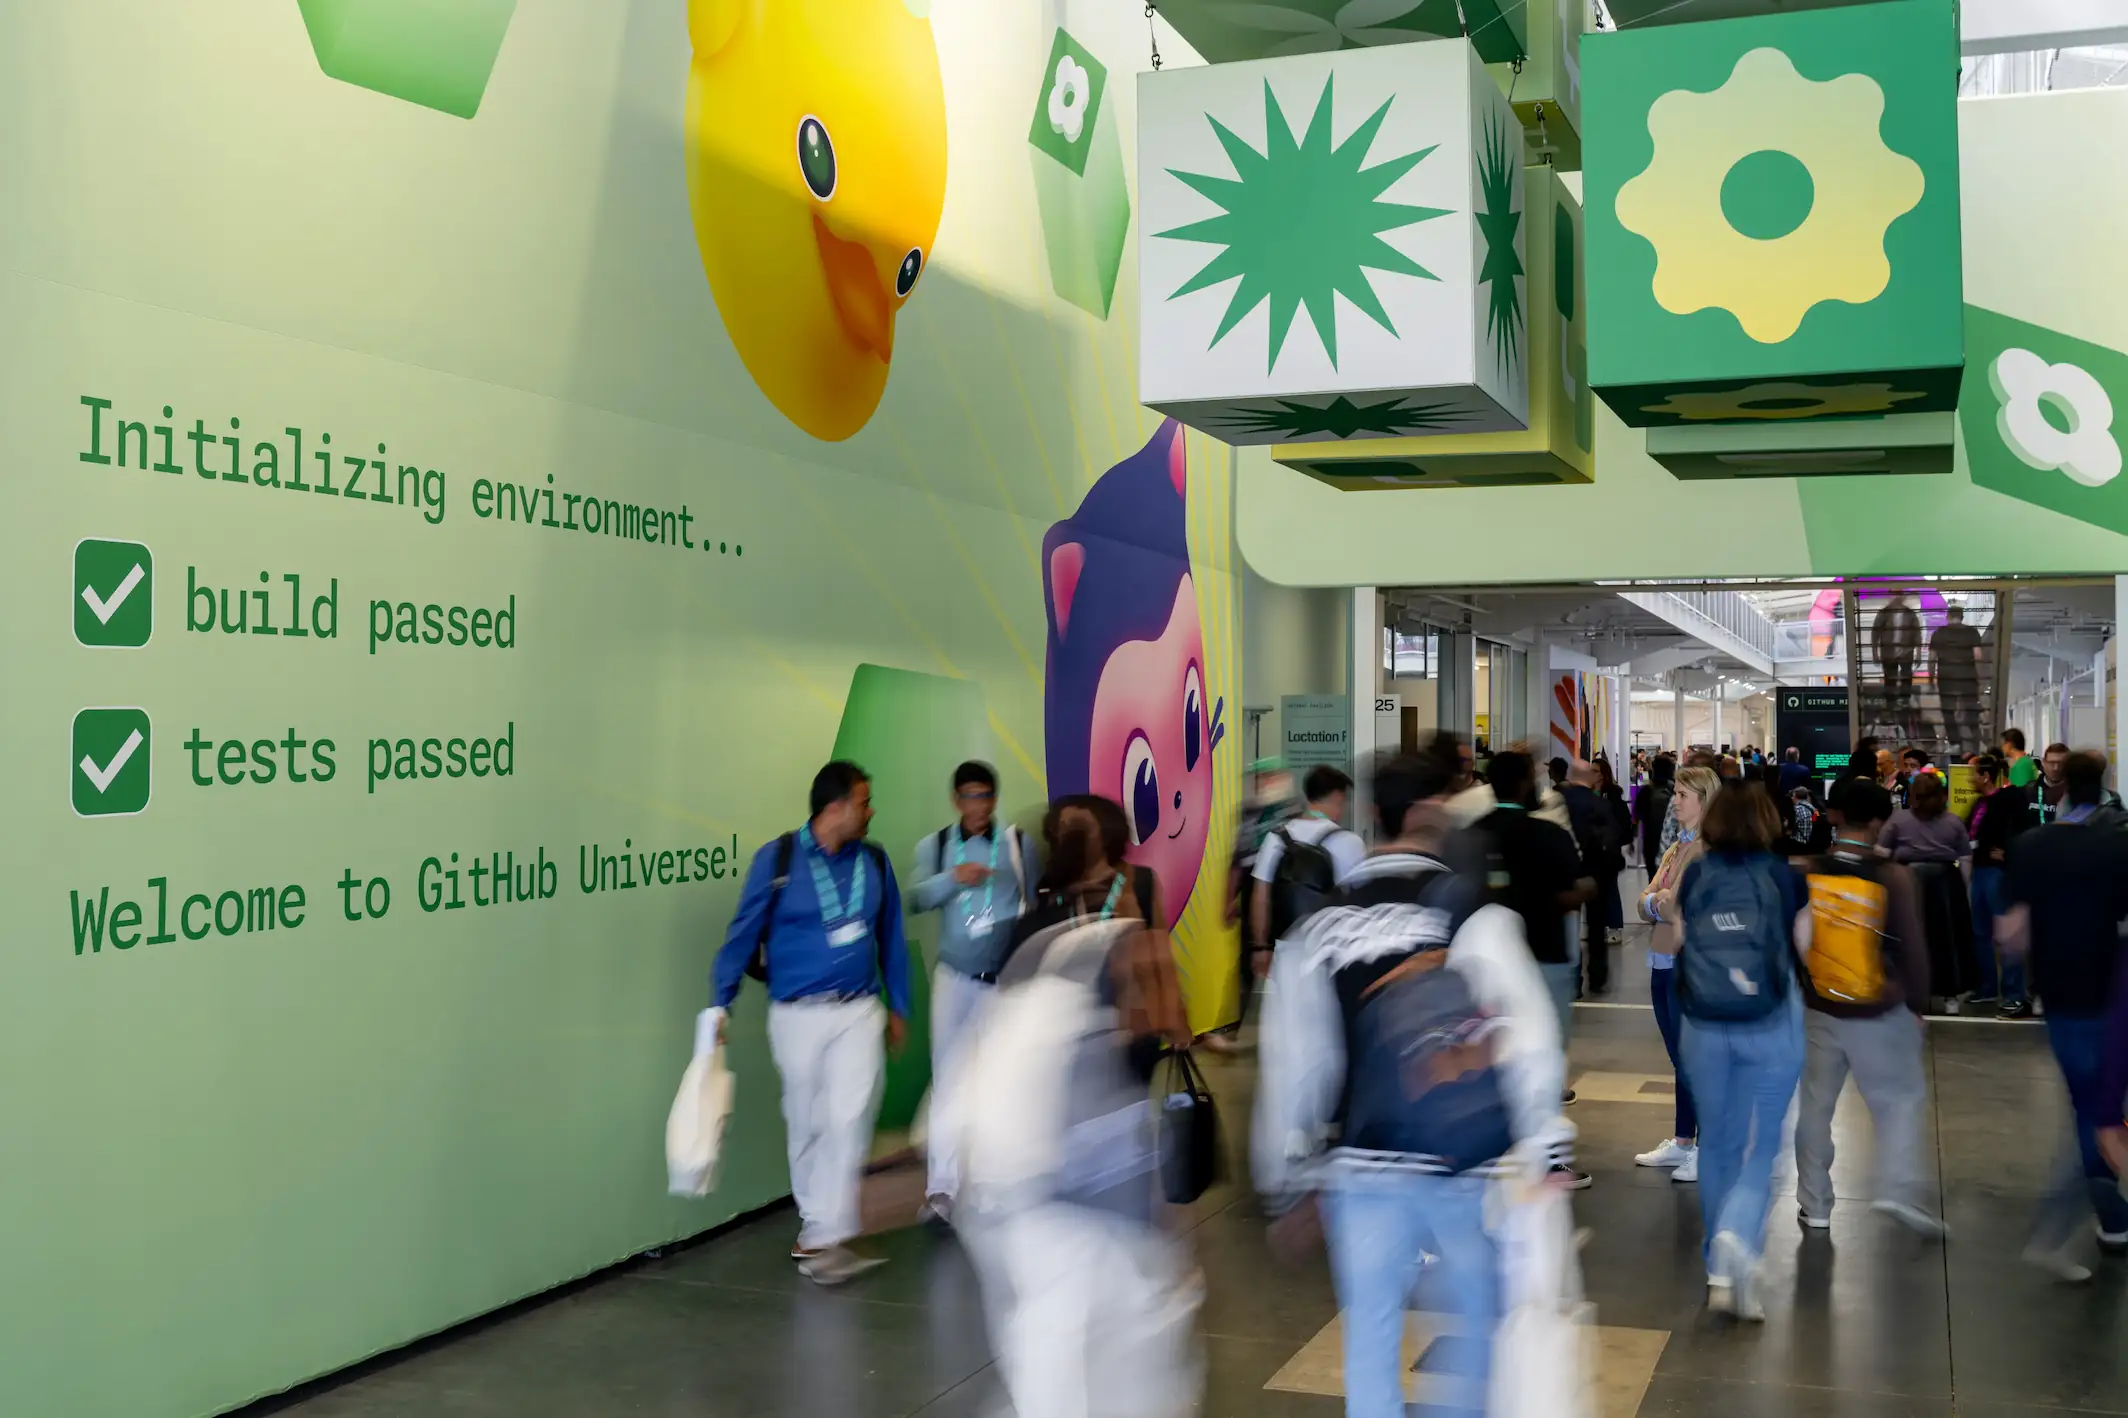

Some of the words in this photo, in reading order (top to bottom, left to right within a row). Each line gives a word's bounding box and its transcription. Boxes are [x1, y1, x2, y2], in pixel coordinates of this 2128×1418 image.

[79, 395, 446, 525] Initializing
[471, 474, 744, 558] environment...
[187, 566, 338, 639] build
[369, 595, 516, 655] passed
[184, 728, 337, 787] tests
[367, 722, 515, 794] passed
[1288, 730, 1339, 743] Lactation
[70, 877, 306, 955] Welcome
[338, 868, 390, 921] to
[418, 846, 558, 913] GitHub
[580, 833, 738, 894] Universe!
